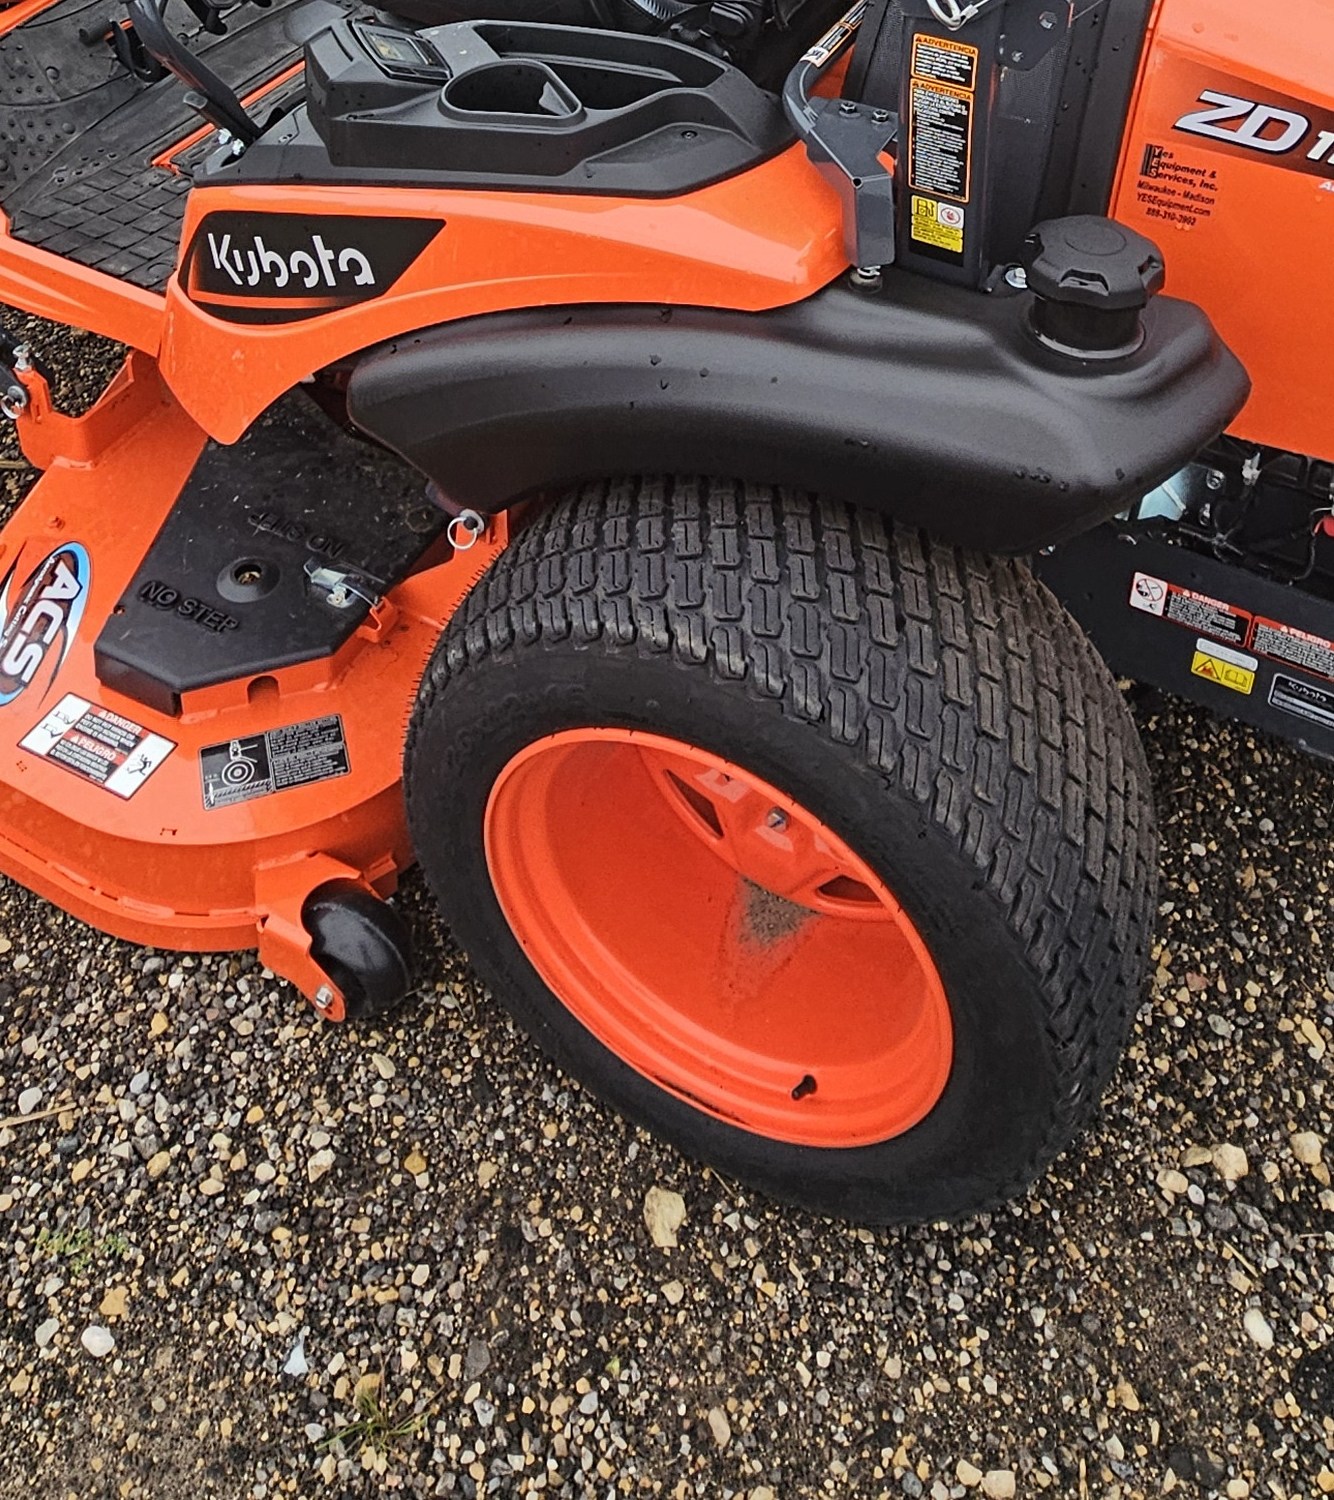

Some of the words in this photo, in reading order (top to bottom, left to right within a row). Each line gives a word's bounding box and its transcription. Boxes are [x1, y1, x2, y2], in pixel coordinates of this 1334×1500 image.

[922, 37, 976, 55] ADVERTENCIA
[920, 83, 971, 100] ADVERTENCIA
[1172, 88, 1312, 155] ZD
[1153, 146, 1174, 159] Yes
[1151, 158, 1206, 177] Equipment
[1149, 168, 1196, 187] Services,
[1199, 179, 1218, 192] Inc.
[207, 232, 375, 288] Kubota
[140, 580, 178, 607] NO
[177, 597, 240, 633] STEP
[1191, 590, 1230, 612] DANGER
[2, 558, 83, 684] ACS
[1289, 626, 1332, 649] PELIGRO
[1288, 681, 1327, 703] Kubota
[105, 711, 144, 735] DANGER
[78, 736, 118, 761] PELIGRO
